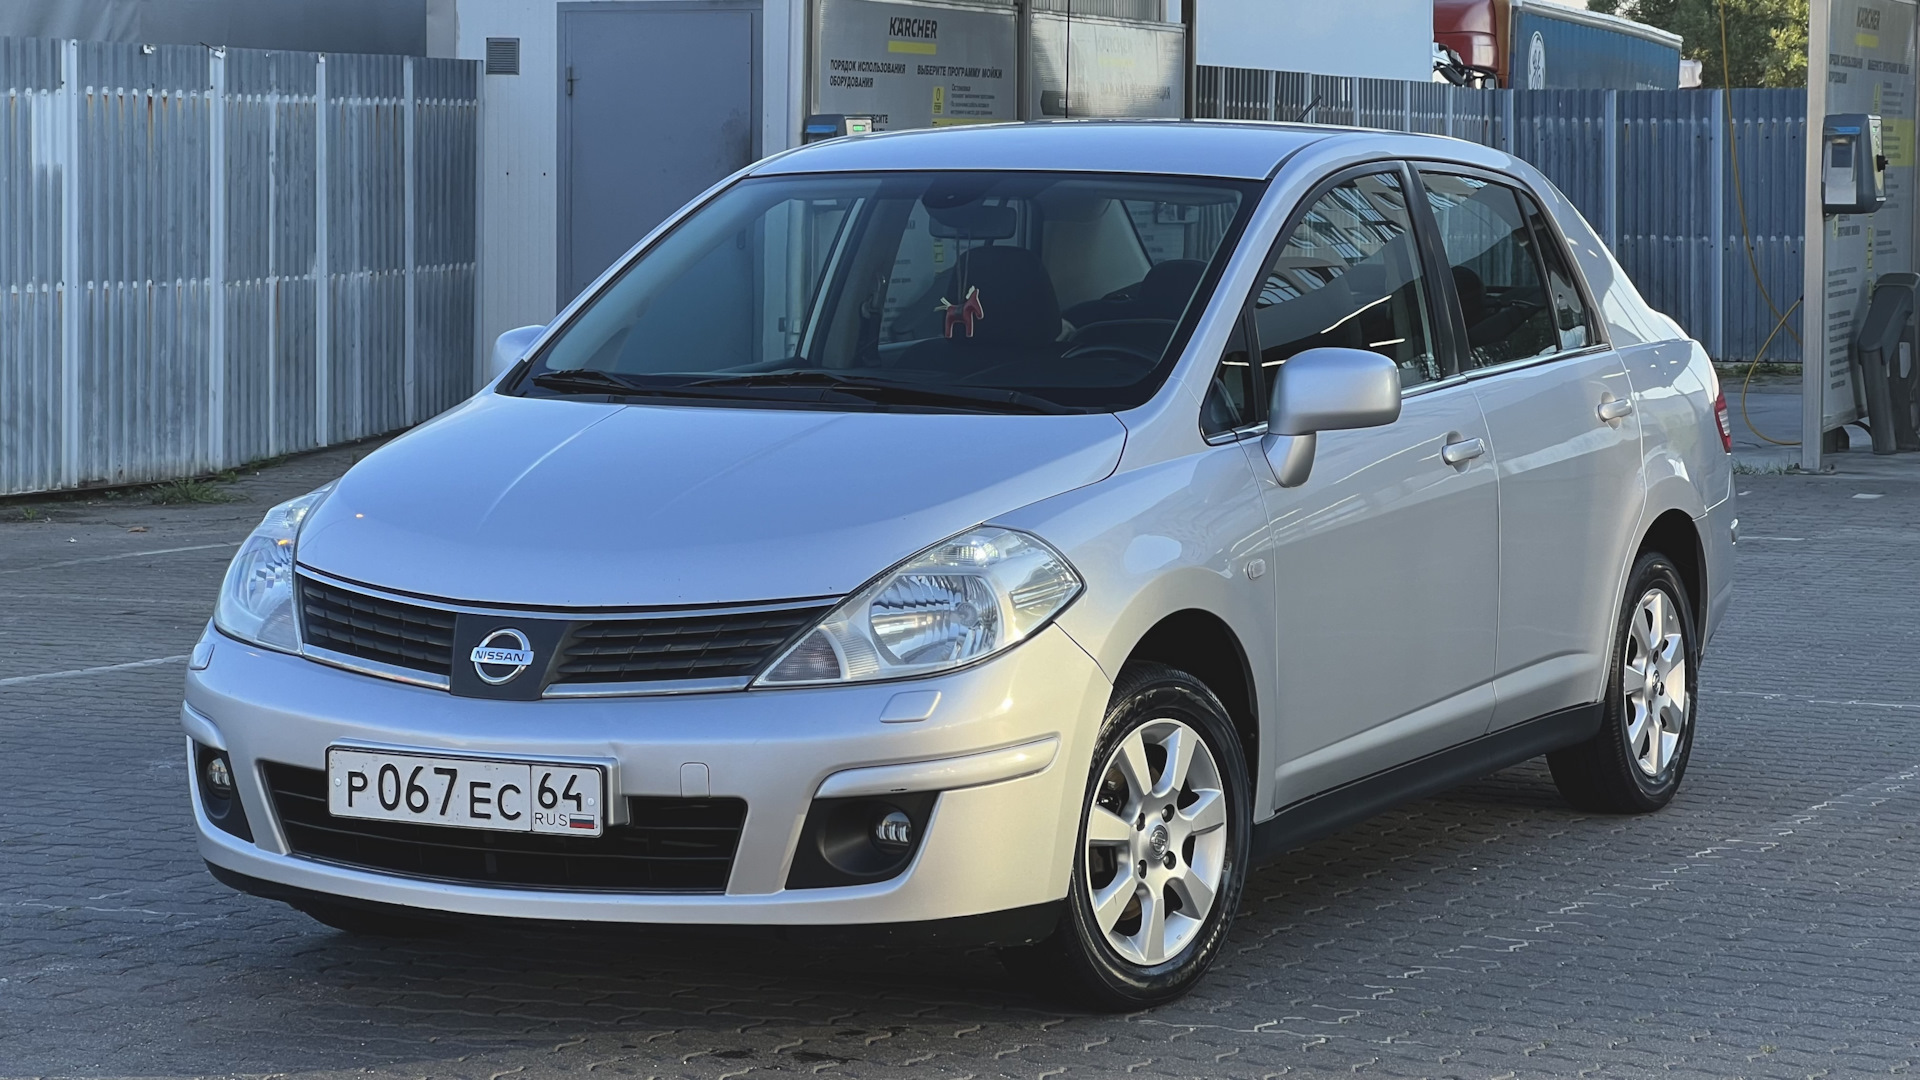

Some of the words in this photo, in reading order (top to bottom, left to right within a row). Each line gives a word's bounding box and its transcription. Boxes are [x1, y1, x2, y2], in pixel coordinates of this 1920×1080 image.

[829, 59, 857, 73] ПОРЯДОК
[857, 61, 906, 75] ИСПОЛЬЗОВАНИЯ
[917, 64, 946, 76] ВЫБЕРИТЕ
[947, 66, 981, 78] ПРОГРАММУ
[982, 66, 1003, 79] МОЙКИ
[829, 75, 874, 89] ОБОРУДОВАНИЯ
[872, 114, 889, 124] ЕСИТЕ
[474, 650, 525, 662] NISSAN
[537, 772, 582, 812] 64
[534, 812, 568, 827] RUS
